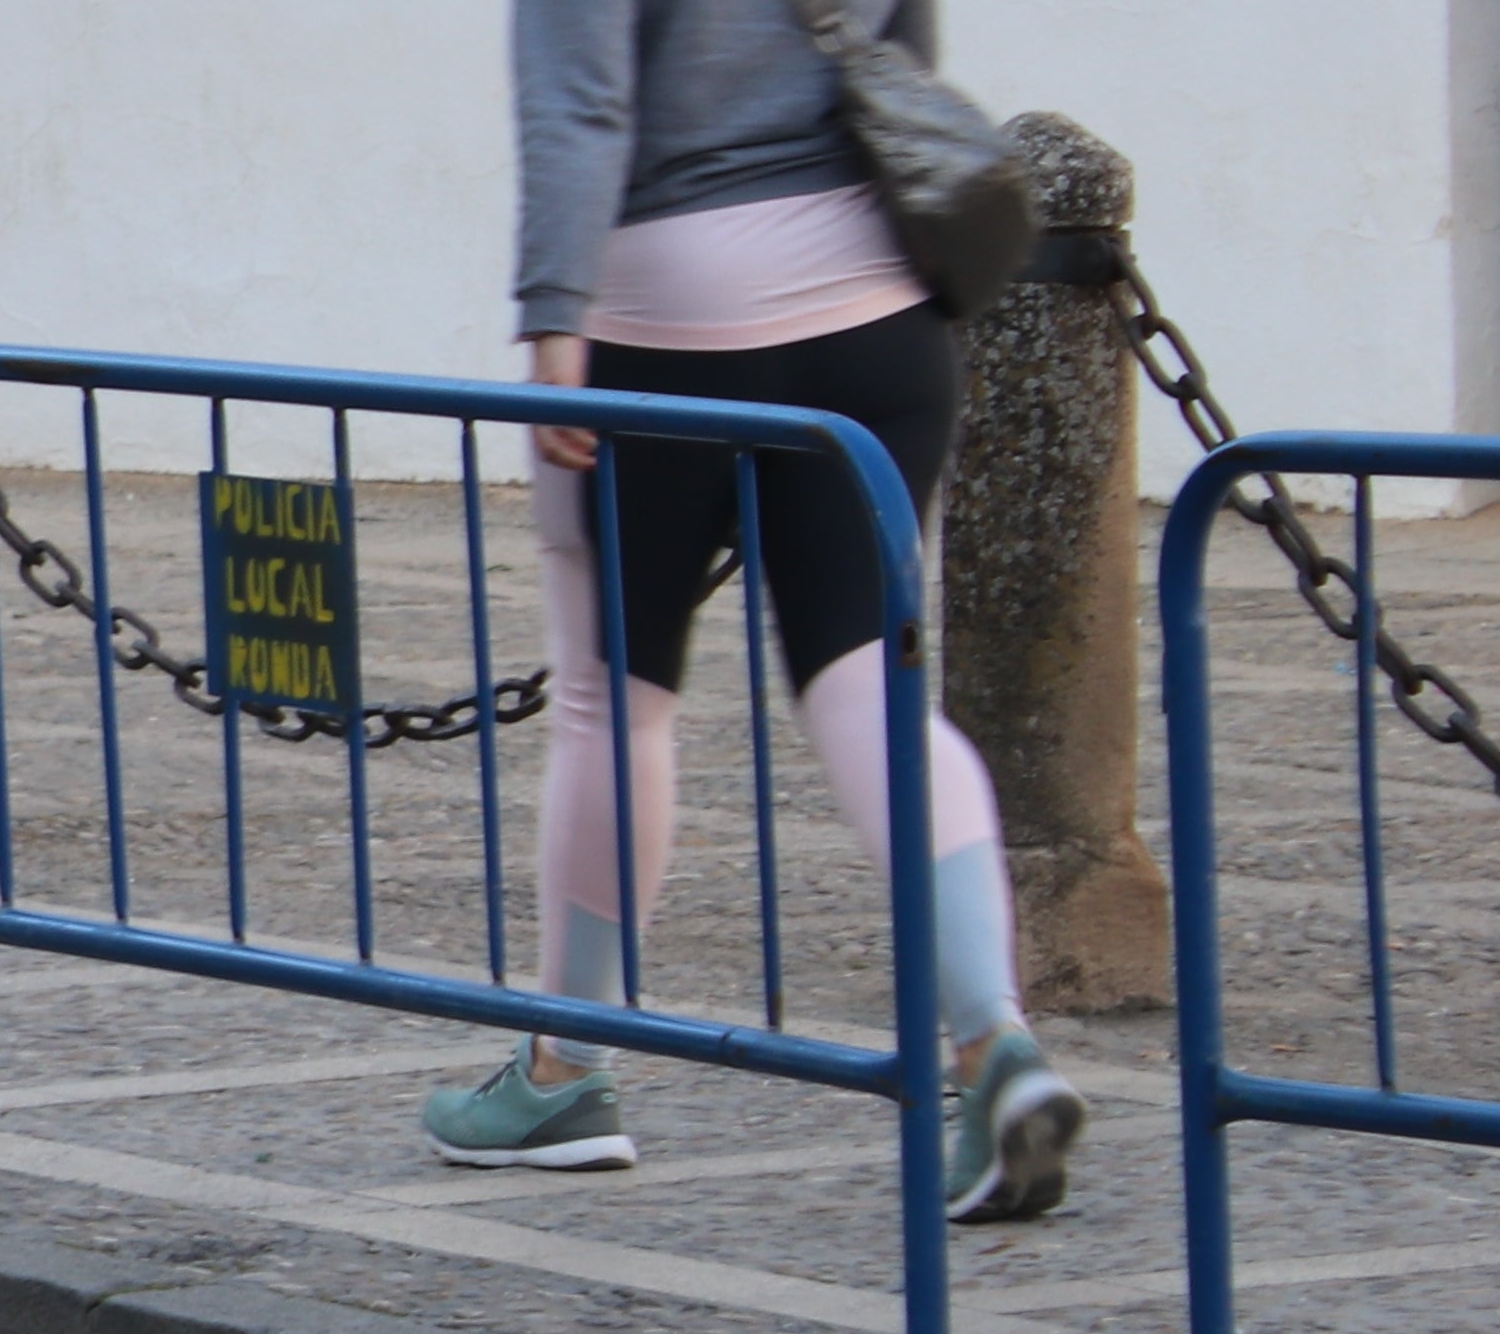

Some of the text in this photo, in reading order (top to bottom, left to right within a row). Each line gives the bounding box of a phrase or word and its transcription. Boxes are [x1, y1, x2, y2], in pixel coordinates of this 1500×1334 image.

[213, 478, 341, 545] POLICIA
[226, 556, 335, 623] LOCAL
[228, 633, 337, 700] RONDA
